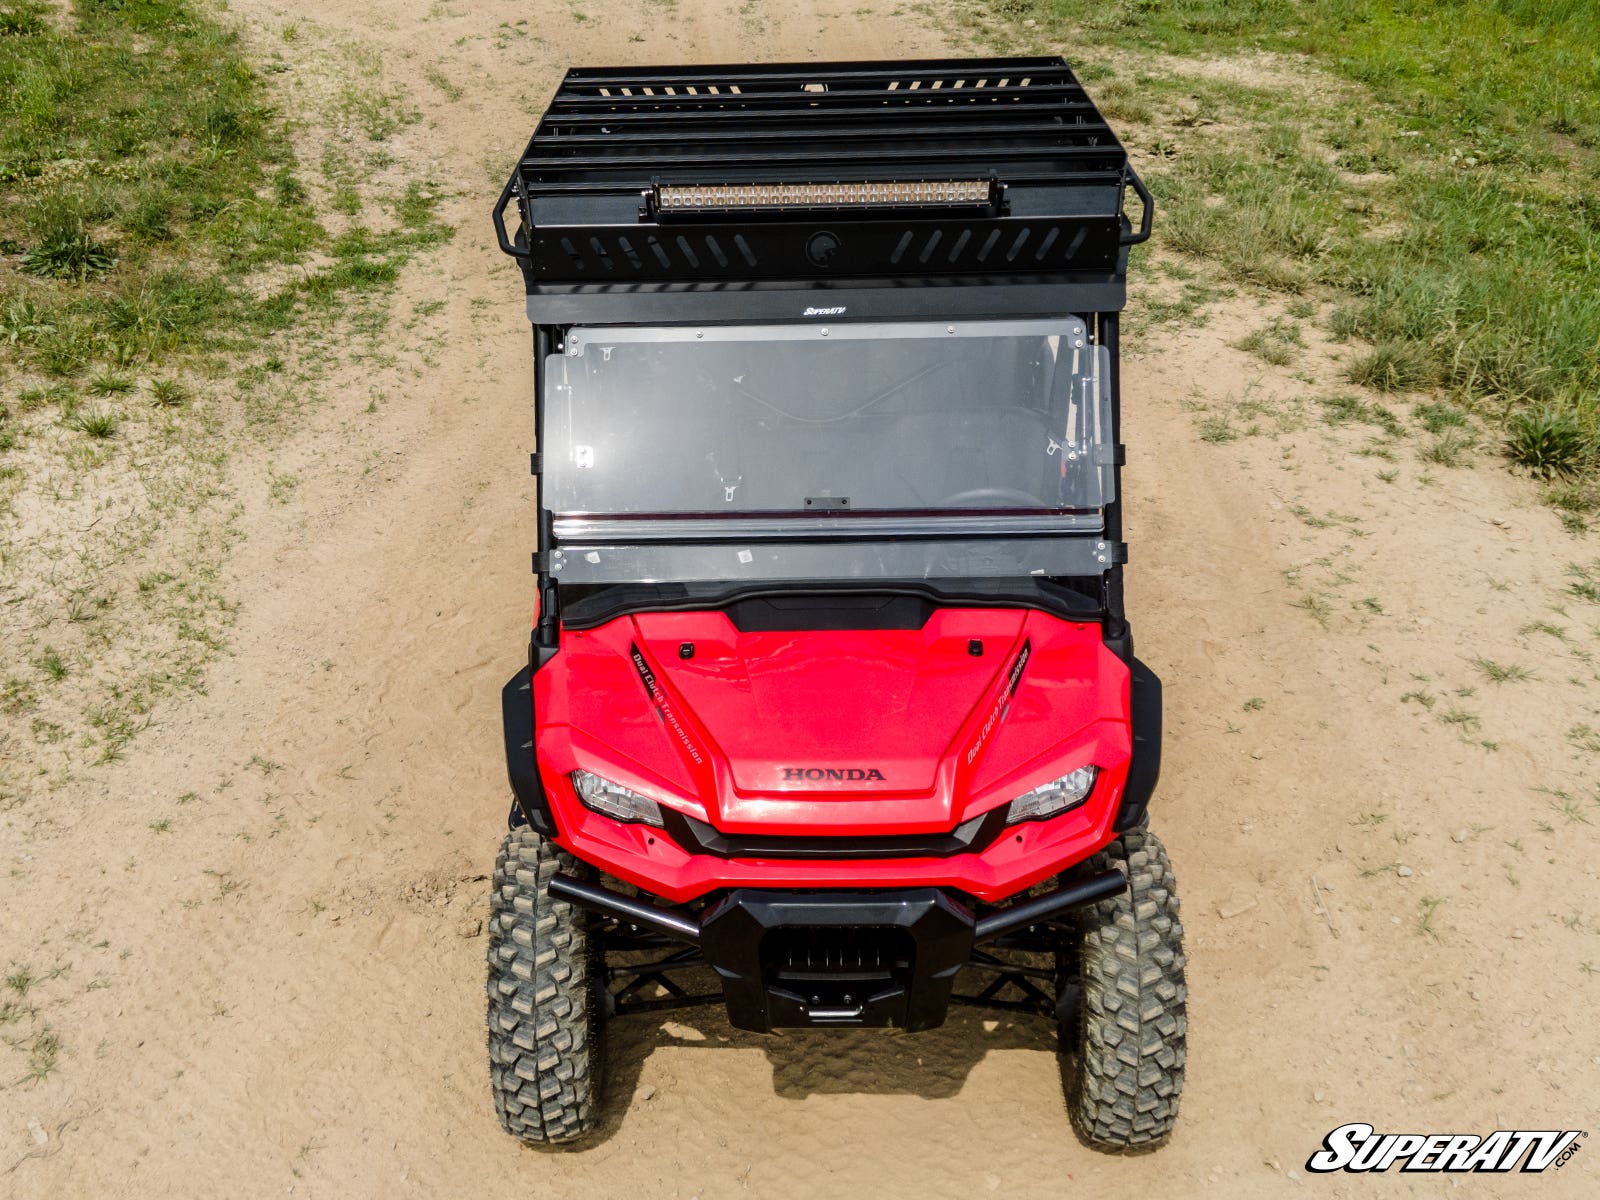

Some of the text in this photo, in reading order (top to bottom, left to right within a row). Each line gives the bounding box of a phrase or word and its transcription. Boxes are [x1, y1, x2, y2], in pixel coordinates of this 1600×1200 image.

[633, 653, 703, 765] Dual Clutch Transmission
[967, 735, 982, 765] Dual
[982, 706, 999, 741] Clutch
[783, 768, 886, 781] HONDA
